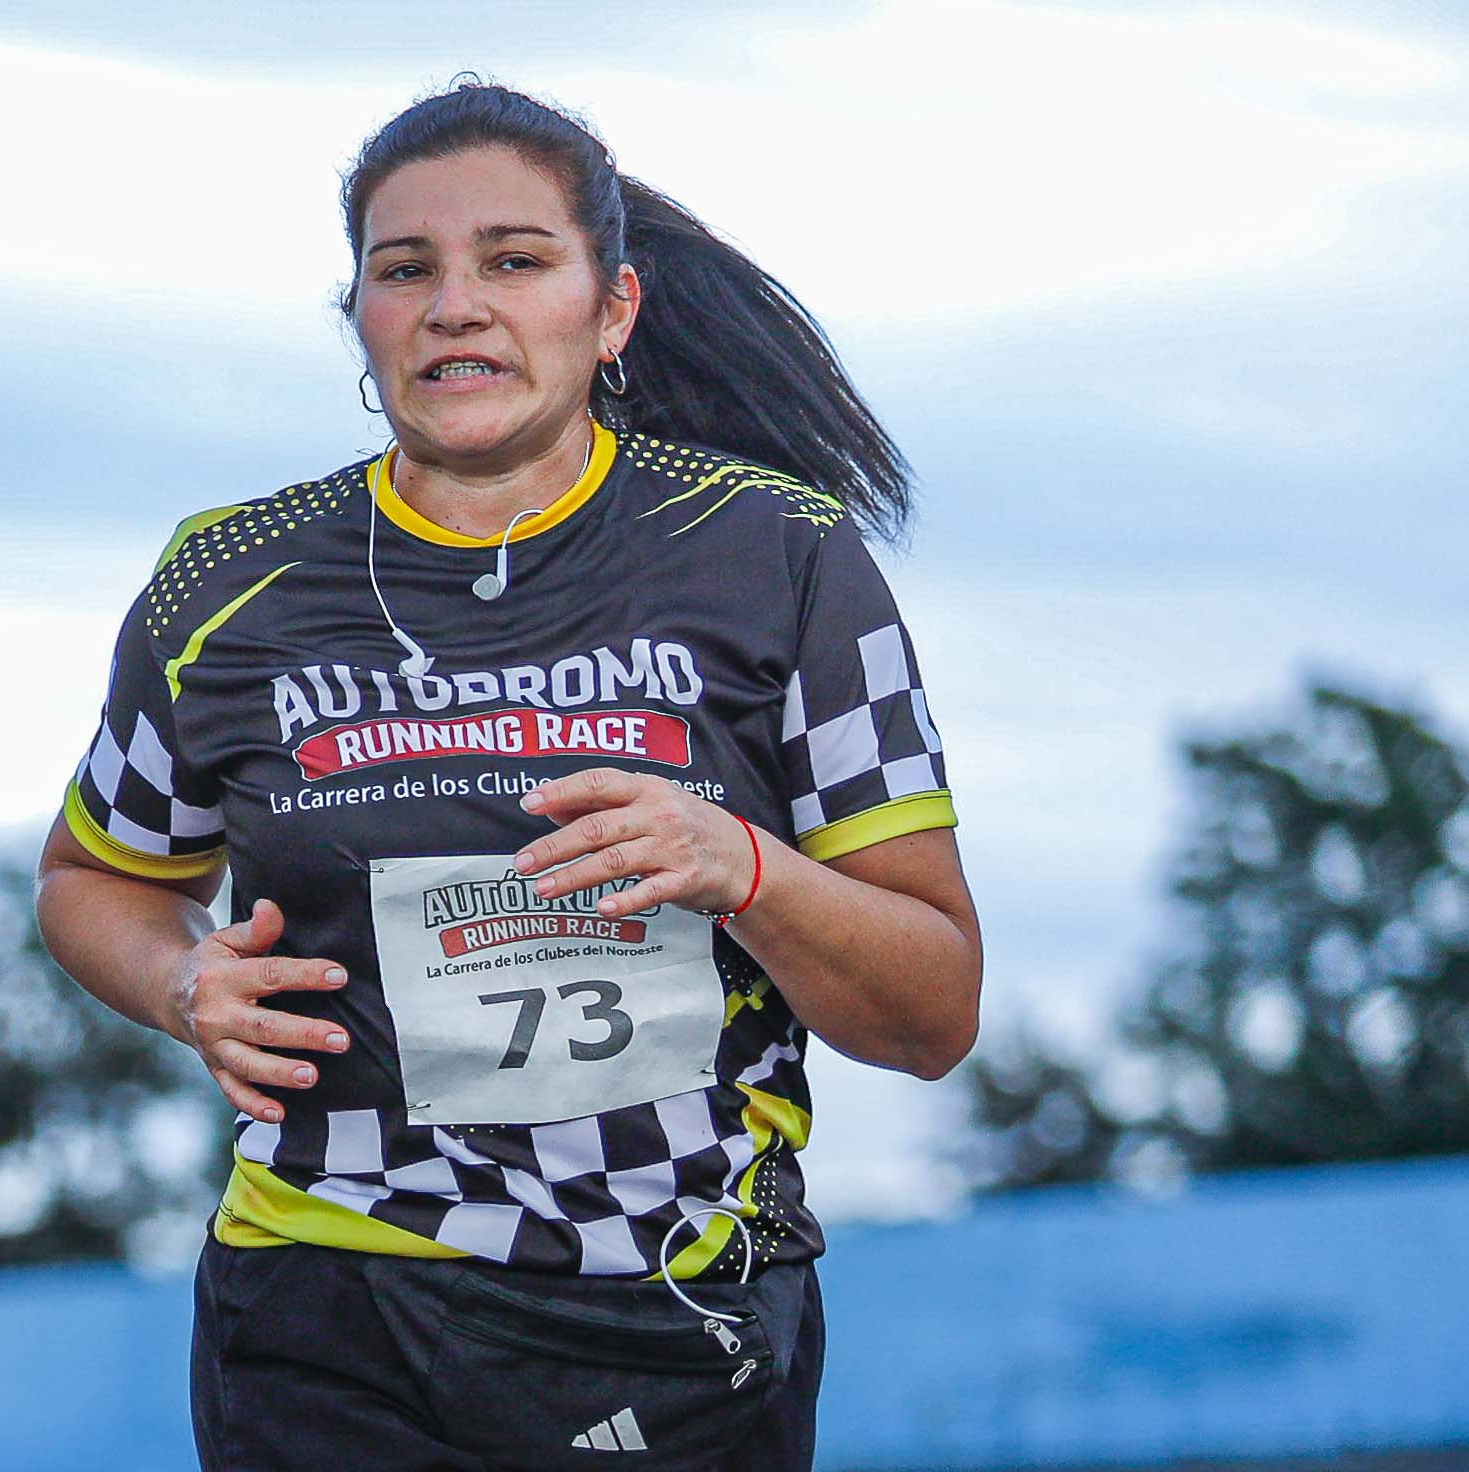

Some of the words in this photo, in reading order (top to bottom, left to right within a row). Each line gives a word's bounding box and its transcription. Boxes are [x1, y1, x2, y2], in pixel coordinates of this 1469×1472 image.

[334, 714, 524, 768] RUNNING
[535, 711, 648, 756] RACE
[269, 792, 292, 815] La
[296, 784, 386, 811] Carrera
[393, 775, 426, 799] de
[431, 773, 470, 796] los
[476, 771, 552, 795] Club
[461, 917, 559, 950] RUNNING
[565, 917, 623, 940] RACE
[425, 965, 442, 979] La
[443, 959, 492, 976] Carrera
[494, 954, 511, 969] de
[514, 951, 534, 965] los
[535, 946, 580, 962] Clubes
[582, 944, 604, 956] del
[606, 943, 664, 957] Noroeste
[477, 979, 635, 1070] 73
